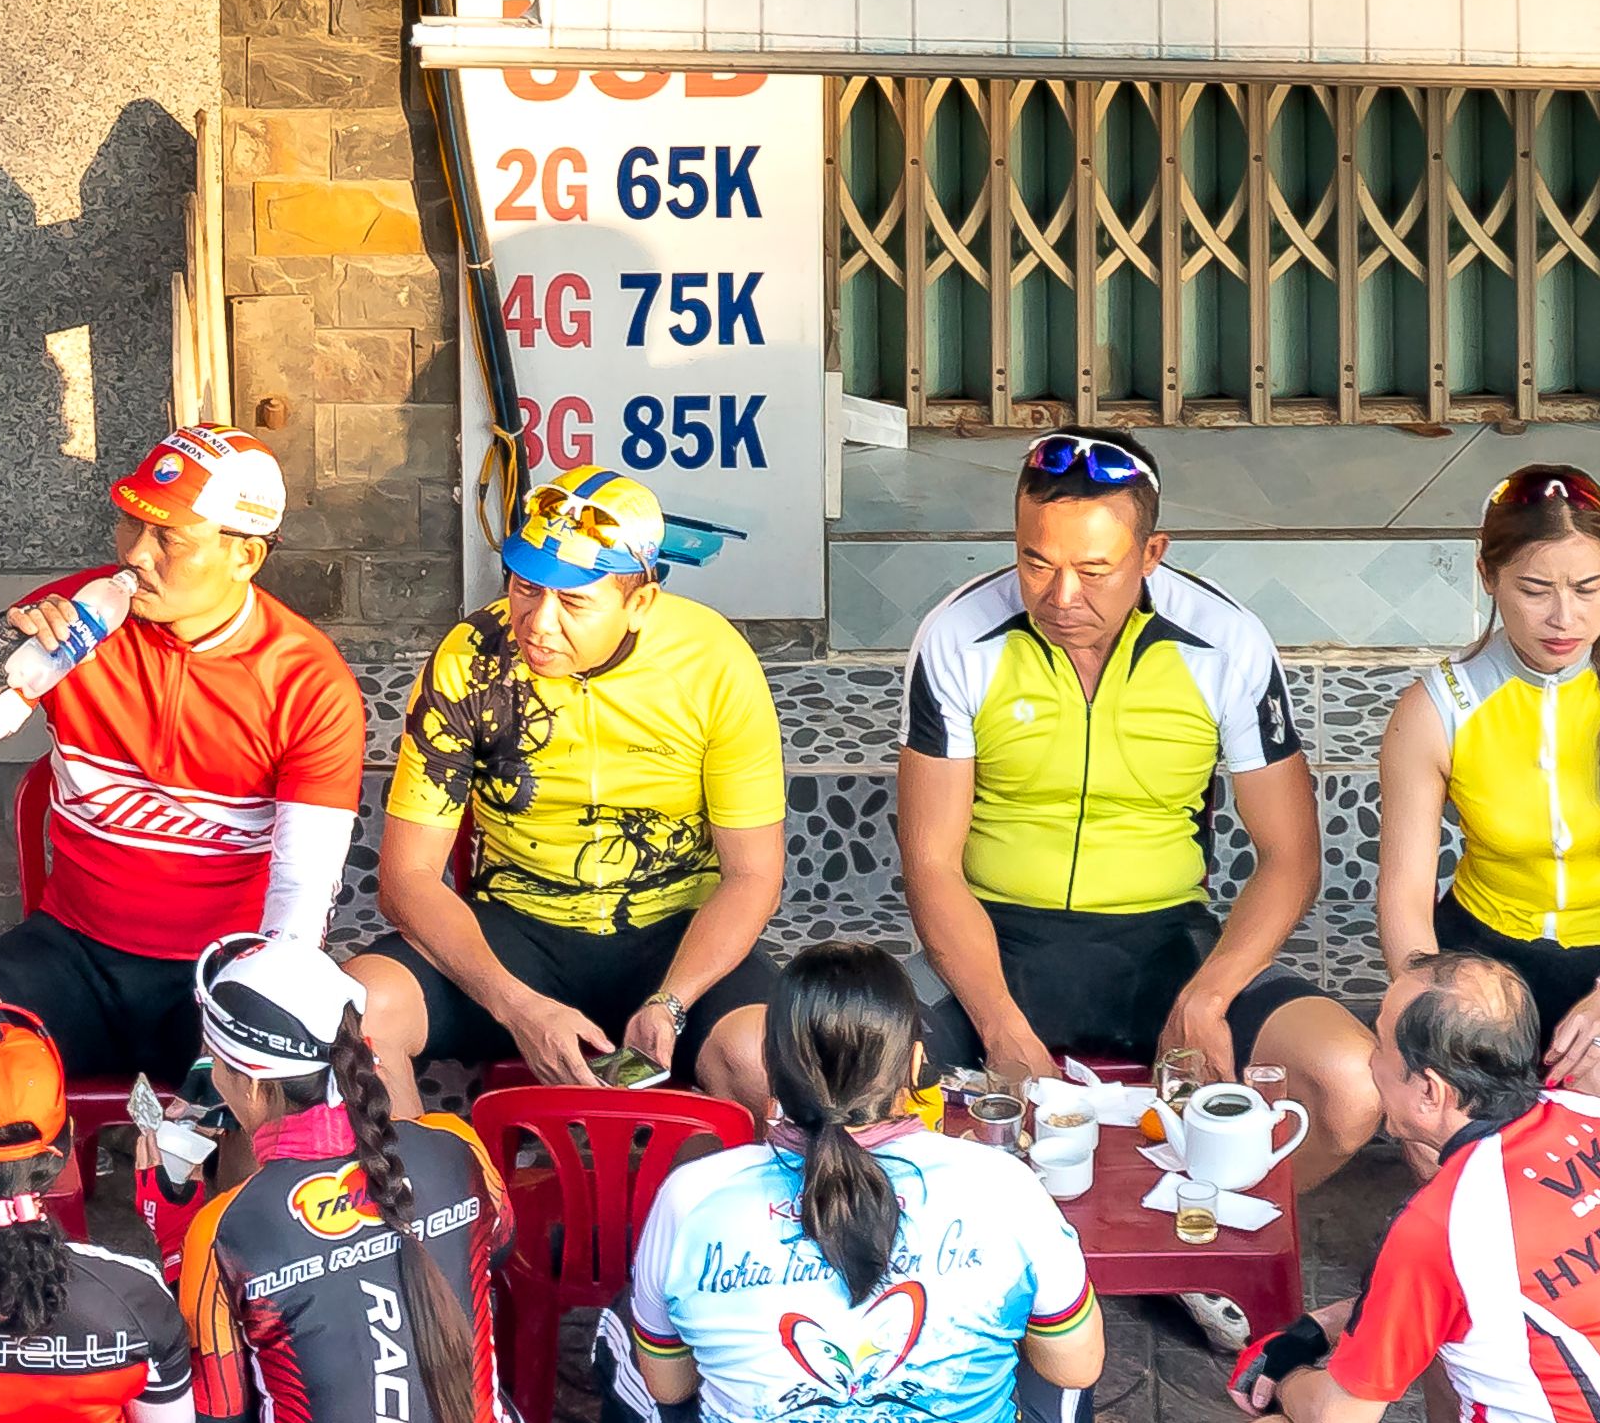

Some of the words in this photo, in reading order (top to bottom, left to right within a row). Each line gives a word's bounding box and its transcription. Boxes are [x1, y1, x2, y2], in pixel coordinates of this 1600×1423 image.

[494, 146, 588, 222] 2G
[616, 143, 763, 221] 65K
[502, 271, 592, 349] 4G
[620, 270, 767, 347] 75K
[621, 394, 767, 471] 85K
